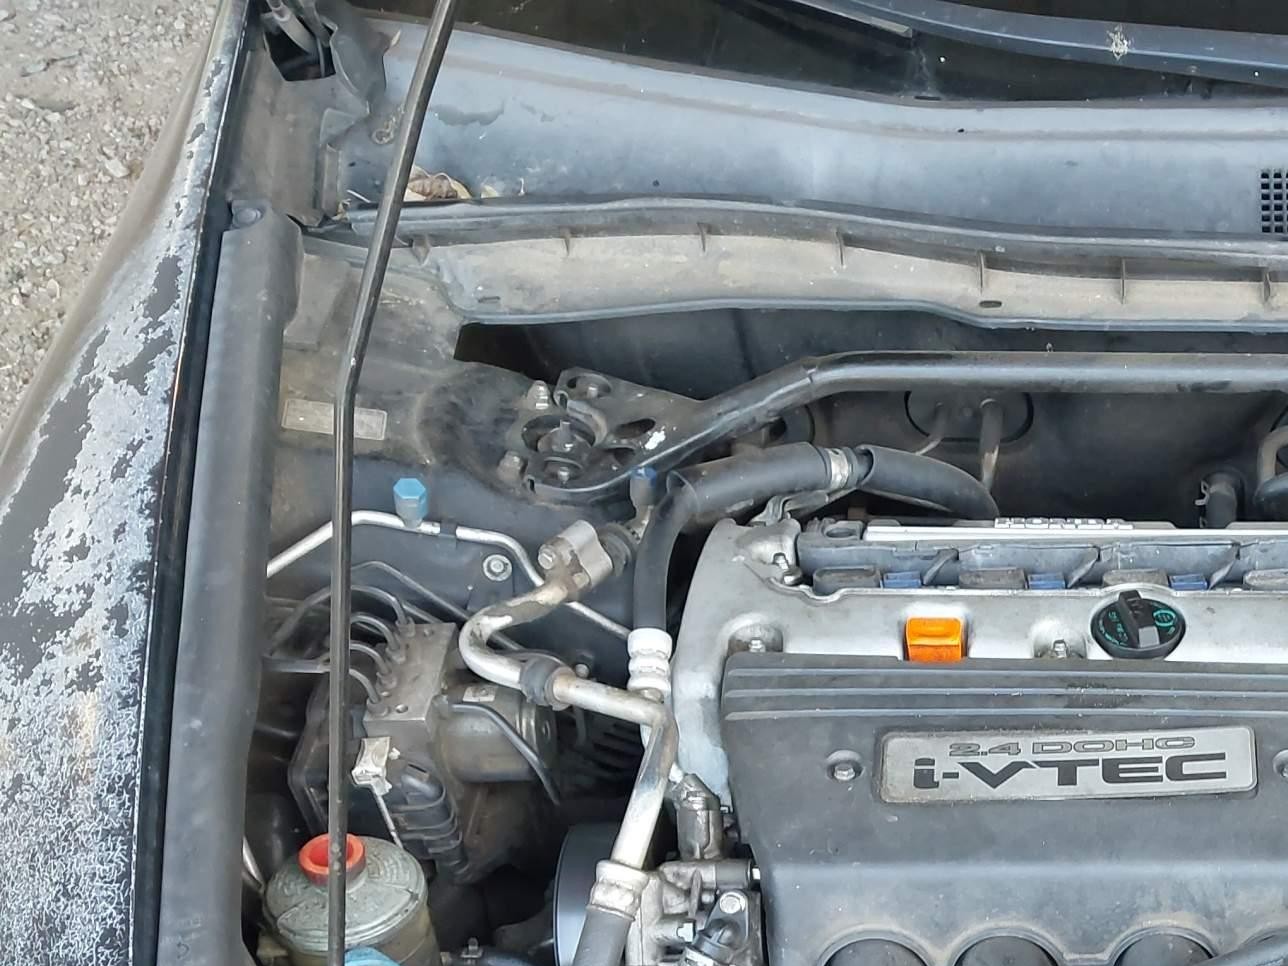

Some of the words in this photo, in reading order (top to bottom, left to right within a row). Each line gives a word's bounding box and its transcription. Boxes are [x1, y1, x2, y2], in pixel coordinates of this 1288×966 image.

[949, 742, 1021, 757] 2.4
[1032, 736, 1196, 755] DOHC
[913, 752, 1227, 790] i-VTEC
